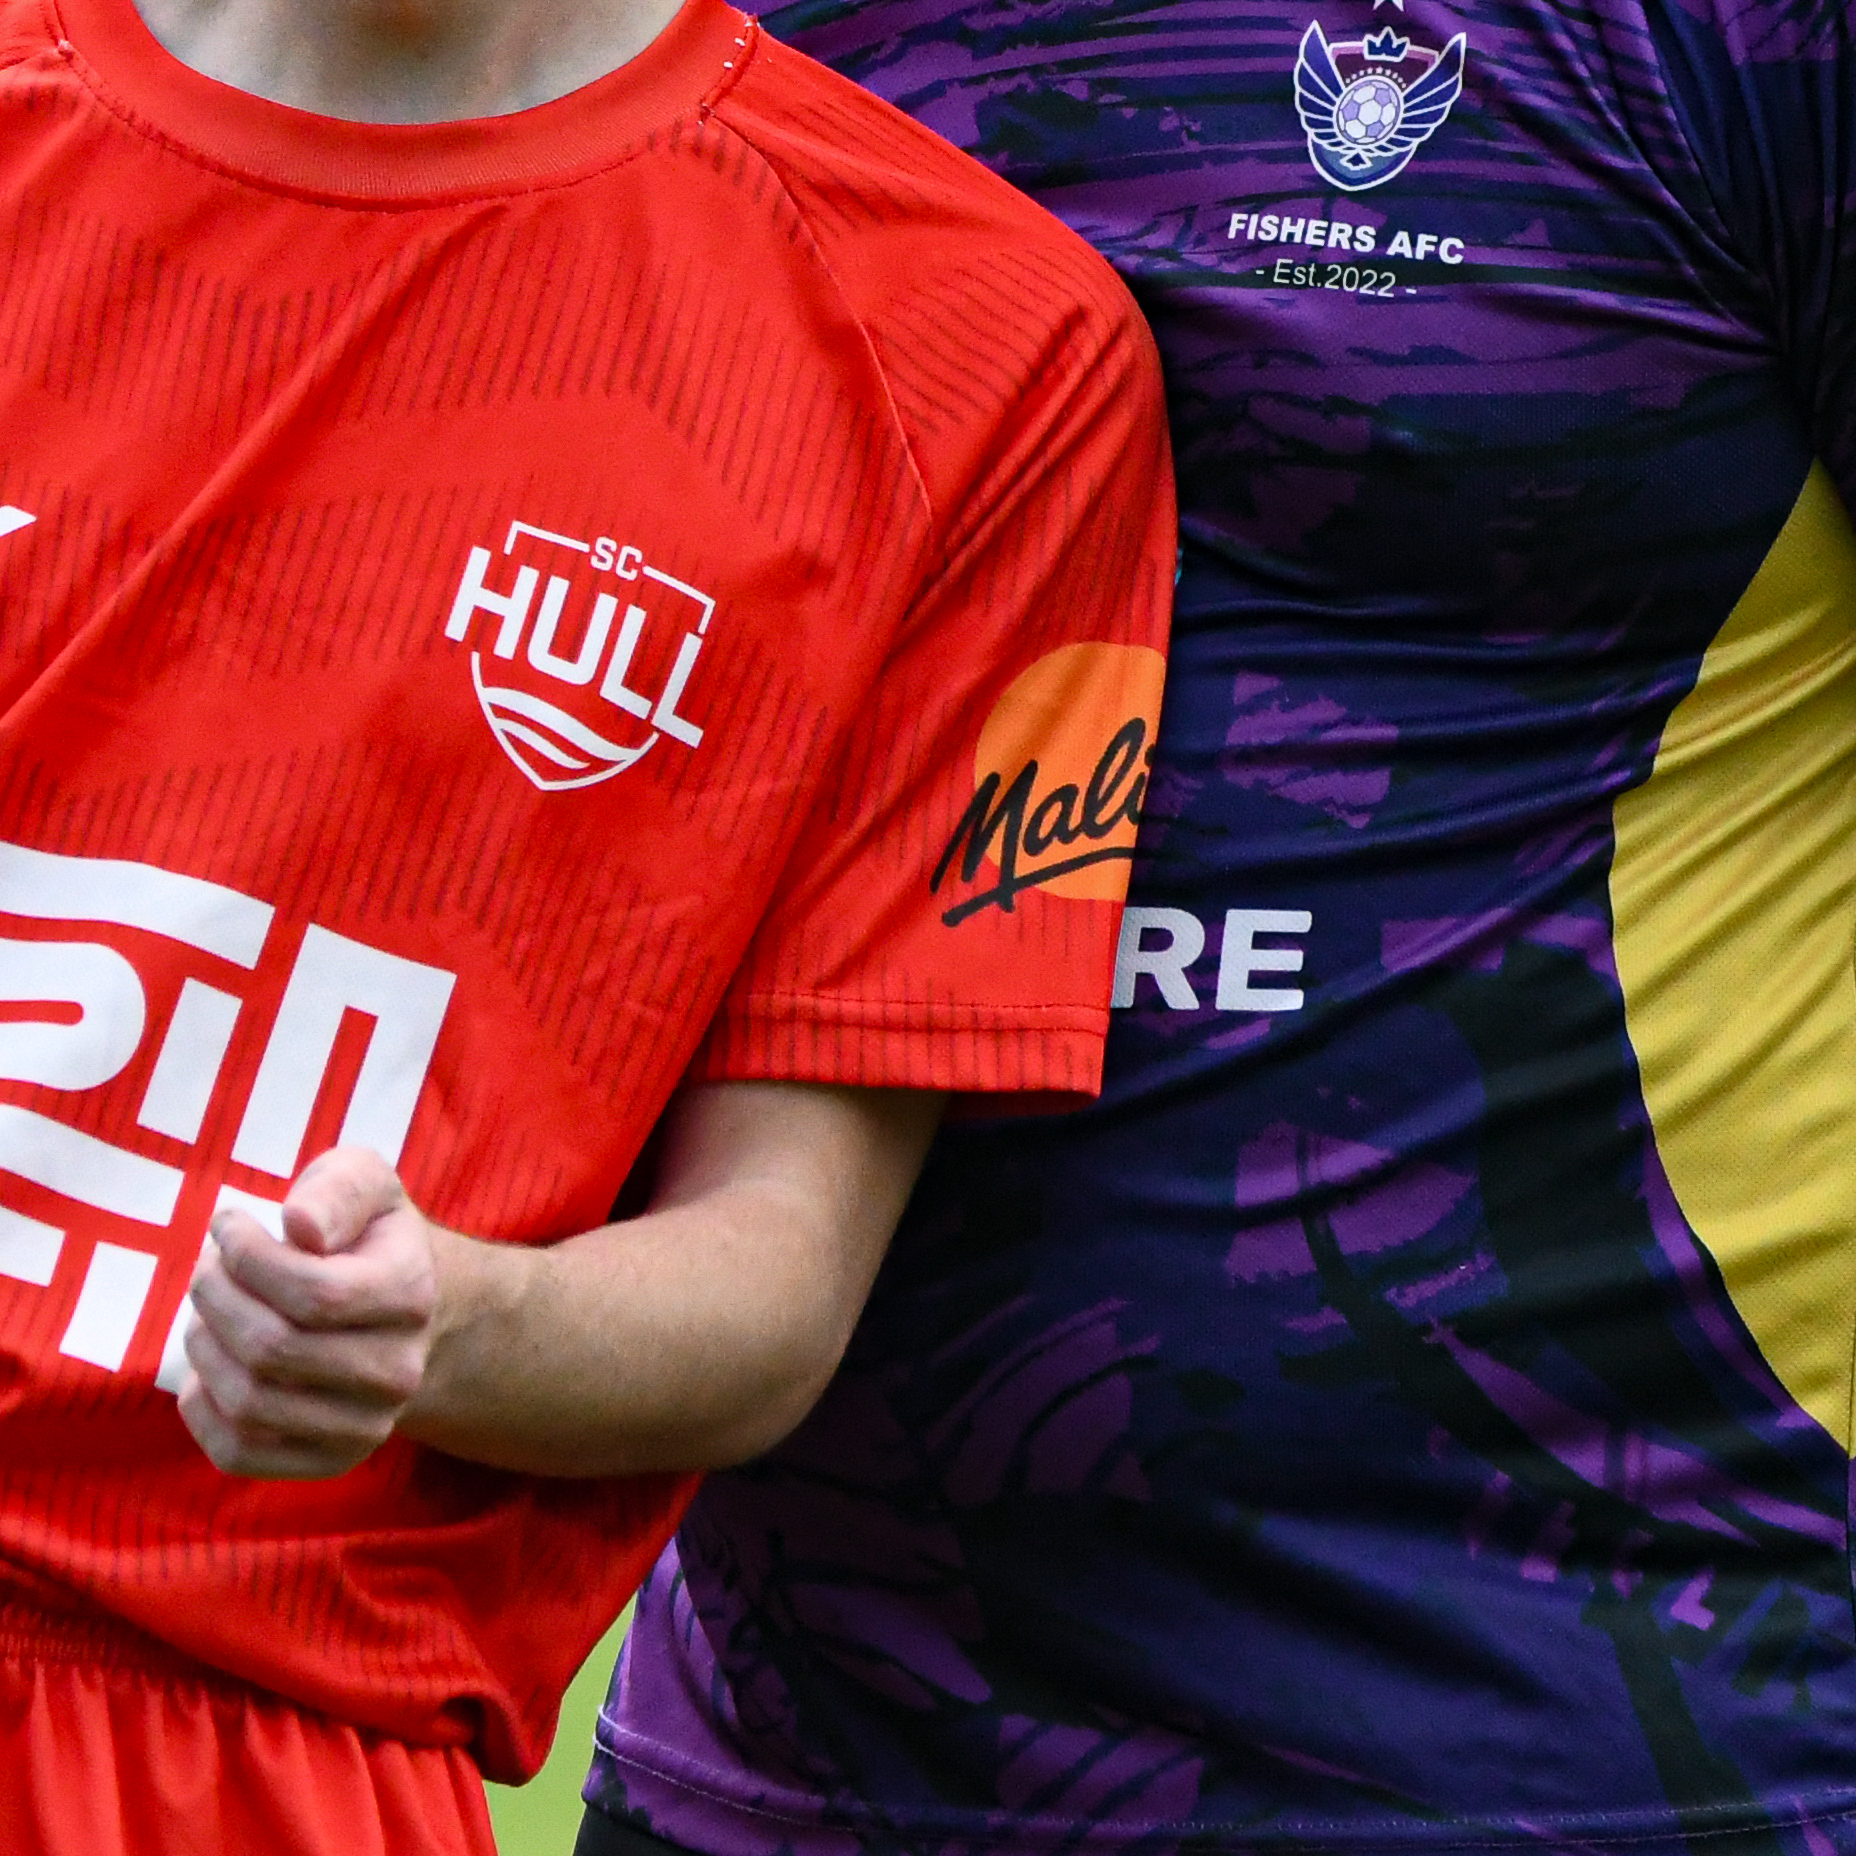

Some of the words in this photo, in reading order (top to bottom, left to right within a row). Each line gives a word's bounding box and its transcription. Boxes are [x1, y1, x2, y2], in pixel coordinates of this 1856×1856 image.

[1228, 213, 1377, 253] FISHERS
[1386, 231, 1465, 264] AFC
[1273, 258, 1396, 298] Est.2022
[590, 536, 643, 581] SC
[445, 546, 704, 748] HULL
